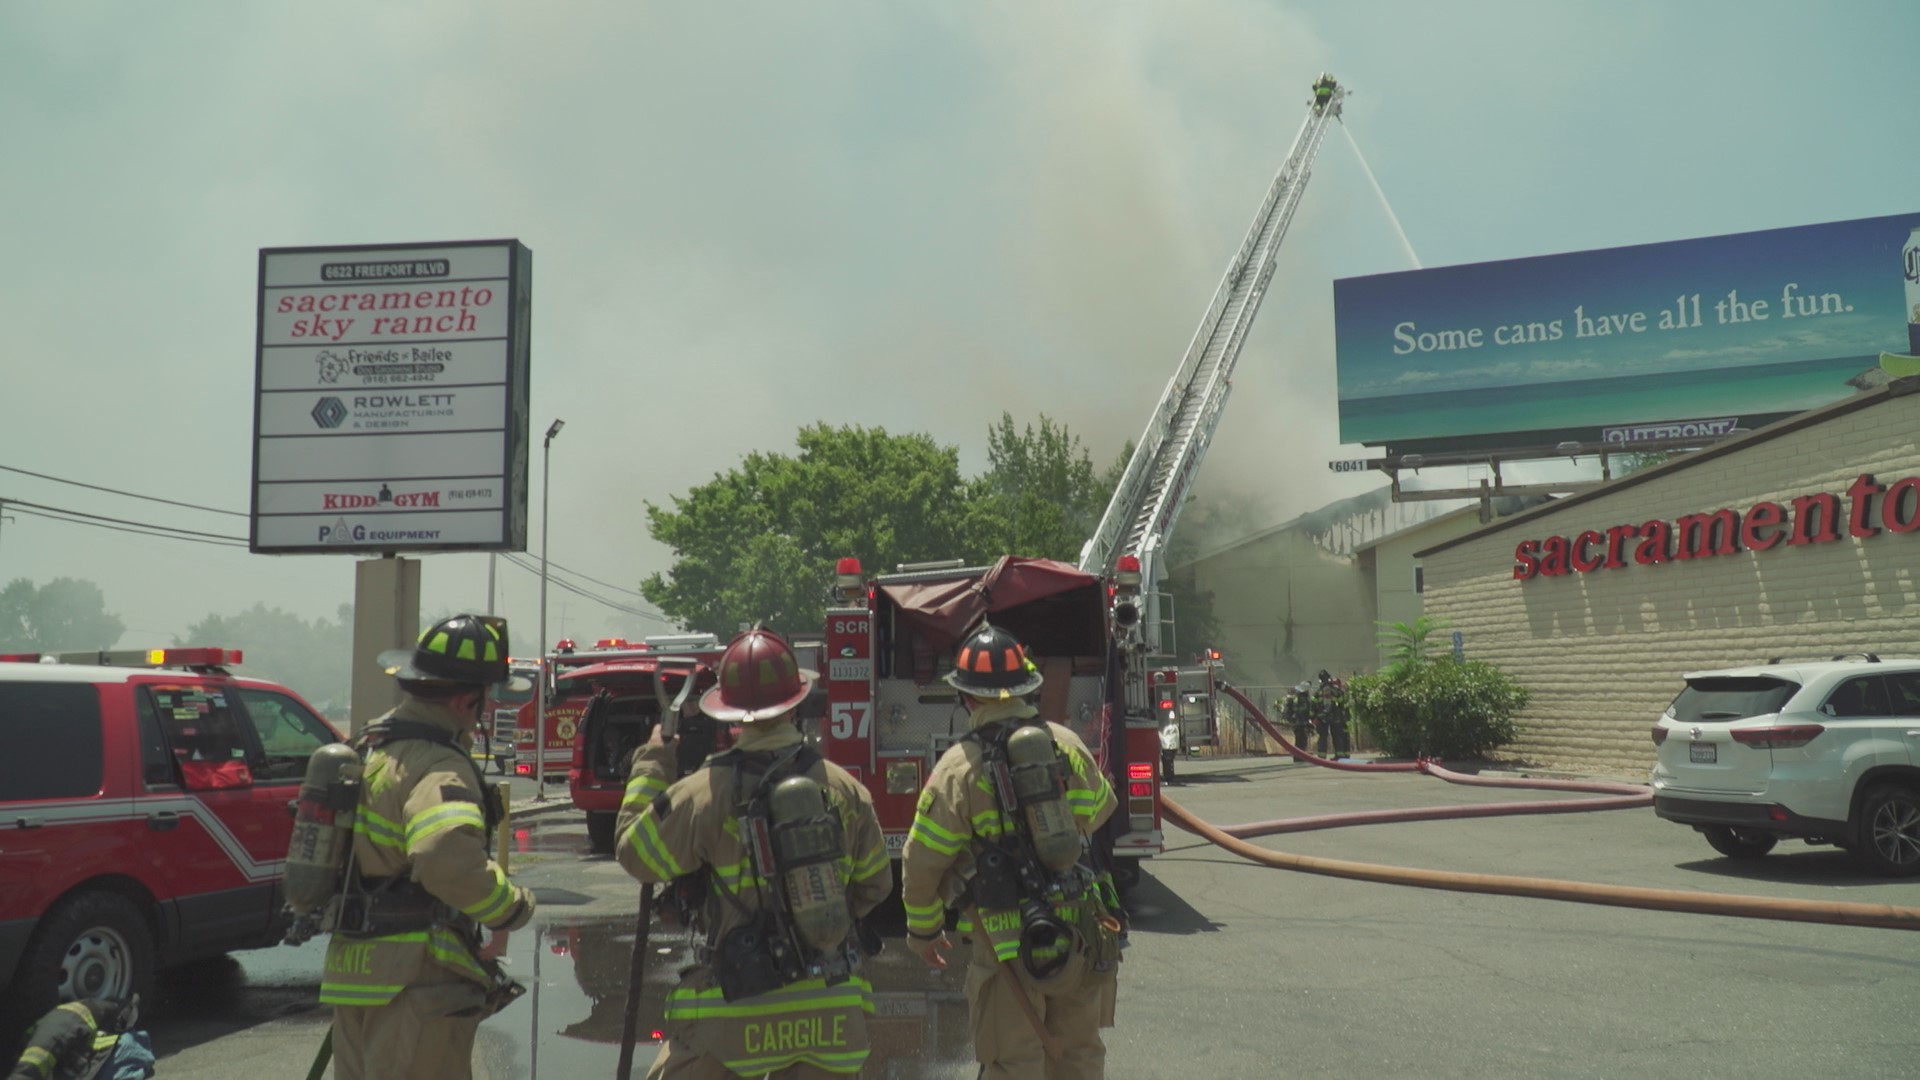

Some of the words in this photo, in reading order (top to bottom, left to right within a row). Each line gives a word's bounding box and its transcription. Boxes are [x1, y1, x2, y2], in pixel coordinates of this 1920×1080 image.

[326, 266, 352, 278] 6622
[355, 263, 413, 277] FREEPORT
[415, 262, 445, 274] BLVD
[277, 285, 493, 313] sacramento
[291, 314, 355, 340] sky
[370, 308, 477, 335] ranch
[1392, 320, 1484, 355] Some
[1494, 314, 1563, 345] cans
[1574, 304, 1647, 338] have
[1659, 294, 1701, 329] all
[1714, 289, 1769, 324] the
[1781, 283, 1855, 318] fun.
[348, 349, 400, 363] Friends
[411, 347, 452, 361] Bailee
[354, 394, 455, 408] ROWLETT
[353, 408, 454, 418] MANUFACTURING
[365, 420, 409, 428] DESIGN
[1608, 421, 1730, 442] OUTFRONT
[1335, 460, 1363, 472] 6041
[323, 493, 377, 510] KIDD
[394, 491, 440, 507] GYM
[369, 530, 441, 541] EQUIPMENT
[1512, 473, 1920, 581] sacramento
[835, 620, 869, 634] SCR
[831, 702, 871, 739] 57
[744, 1014, 847, 1053] CARGILE
